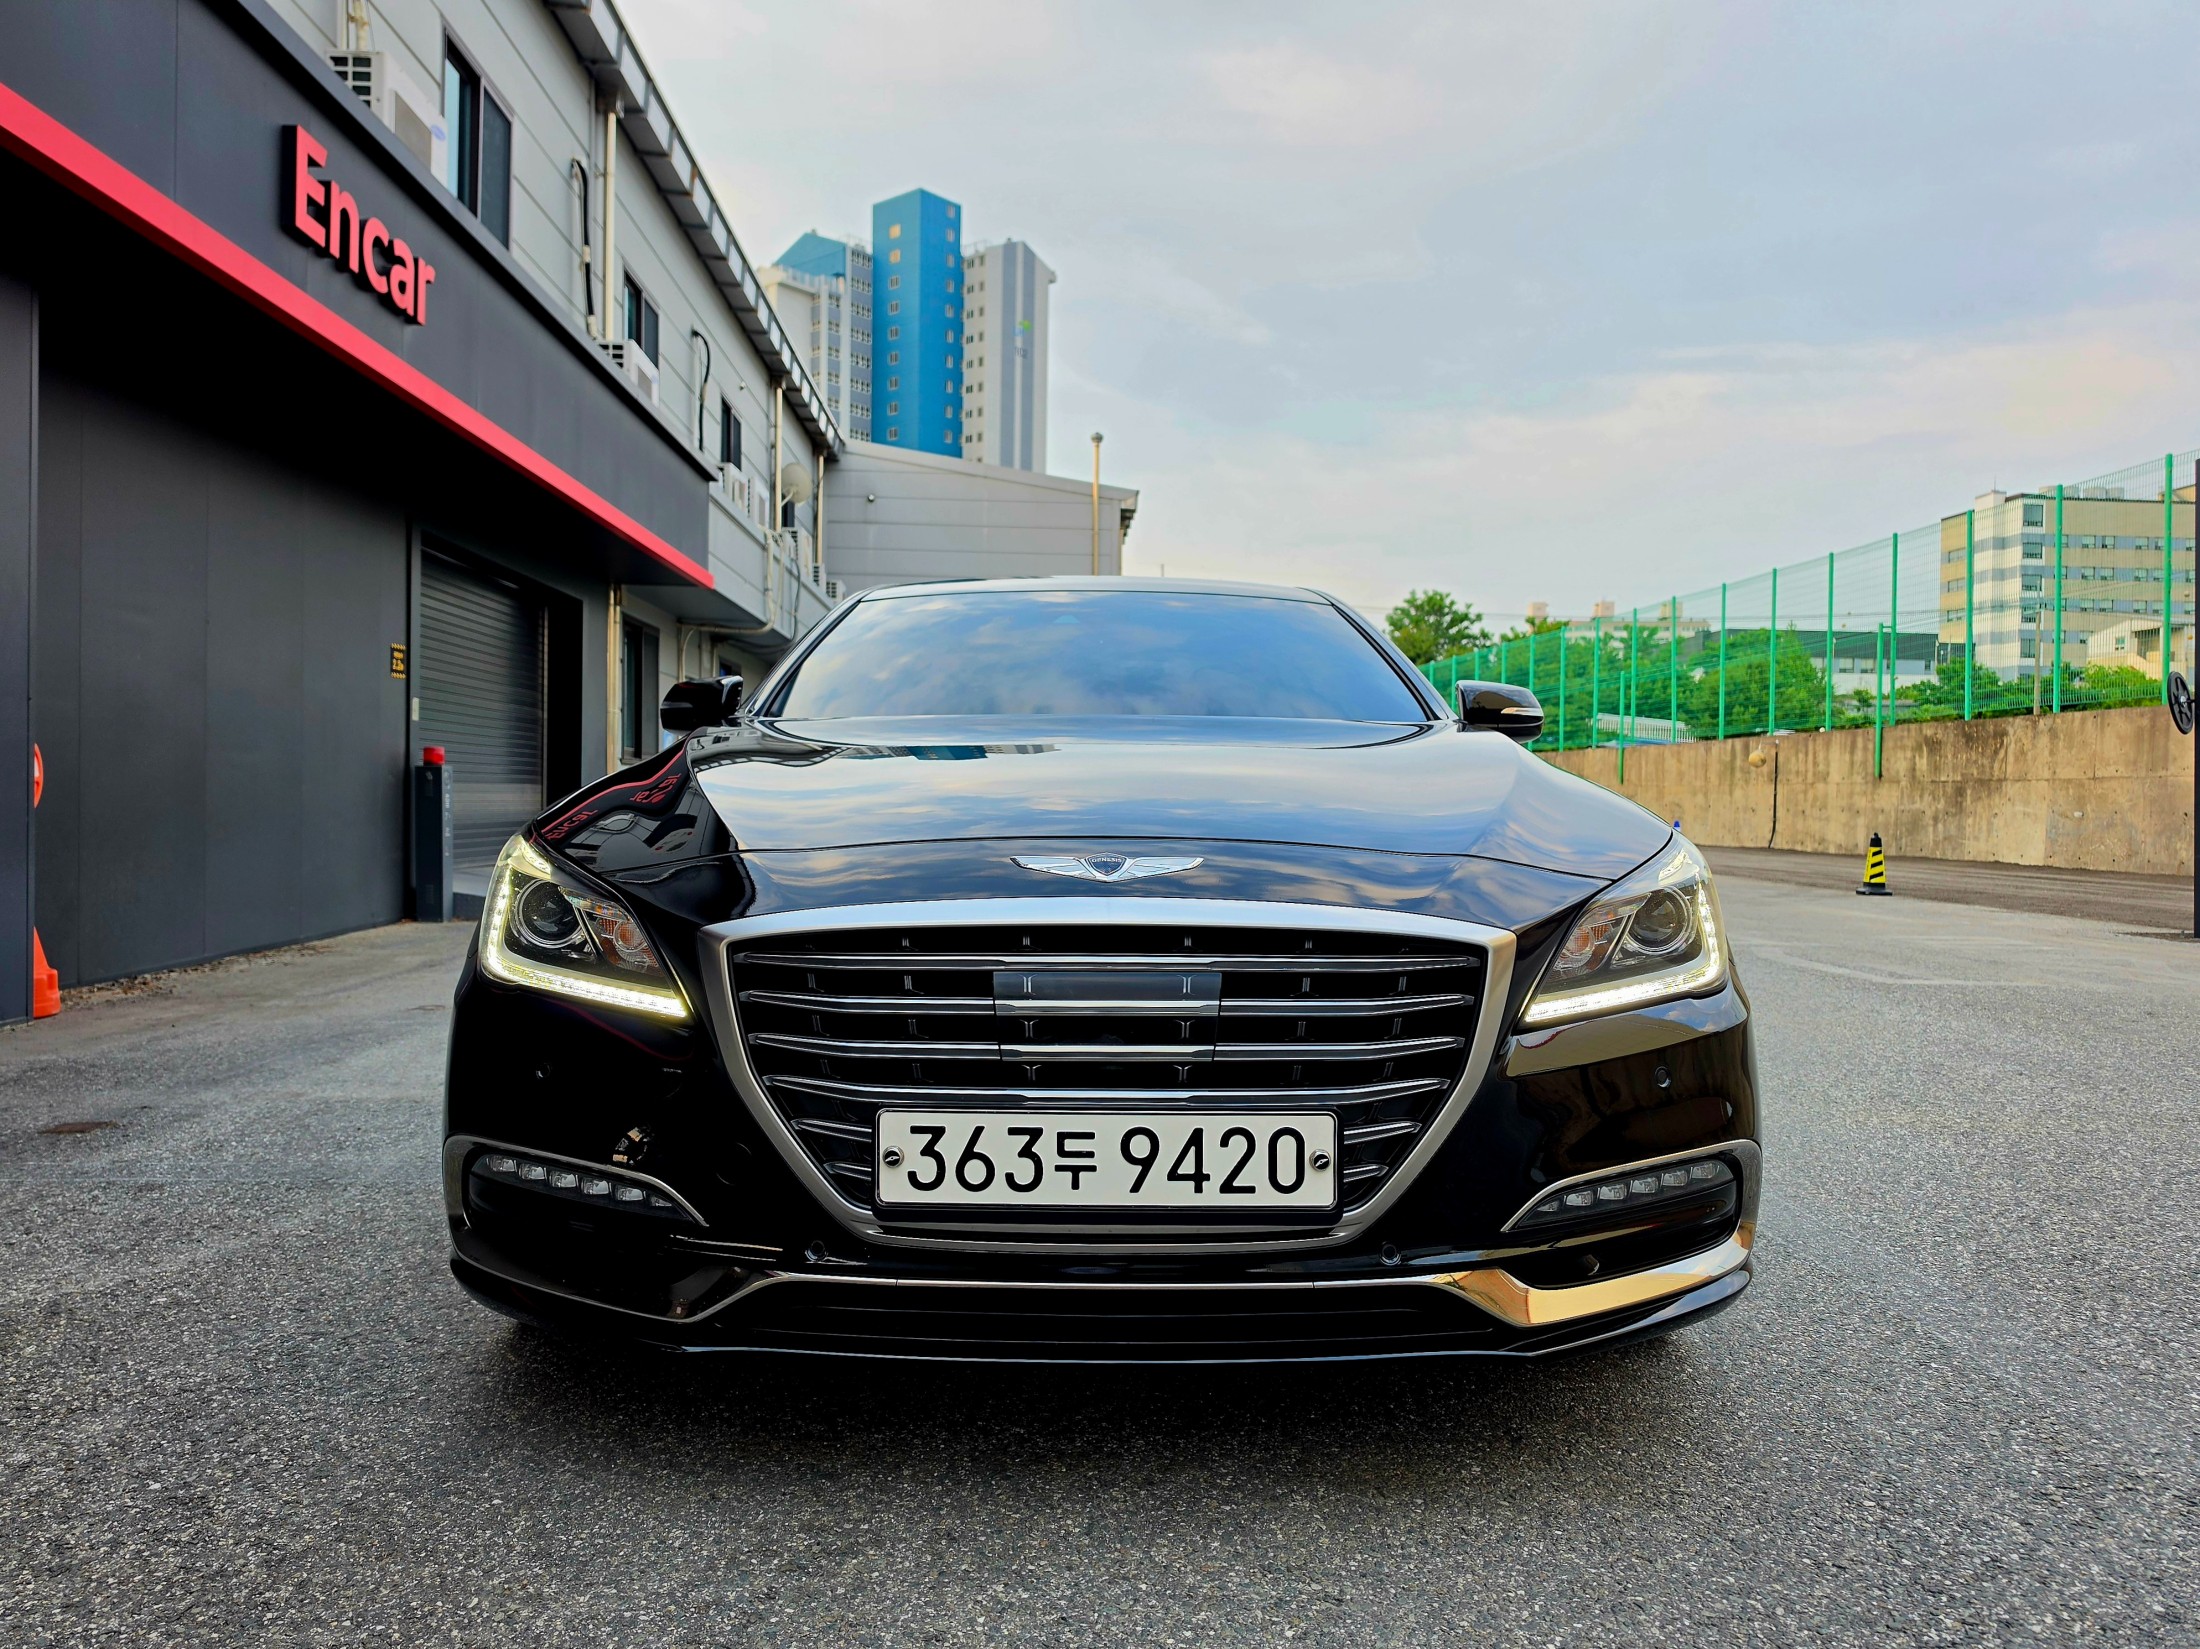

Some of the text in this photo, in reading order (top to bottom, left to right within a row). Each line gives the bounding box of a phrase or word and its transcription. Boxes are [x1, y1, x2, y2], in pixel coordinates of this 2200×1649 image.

[294, 123, 436, 326] Encar
[906, 1125, 1306, 1194] 363두 9420
